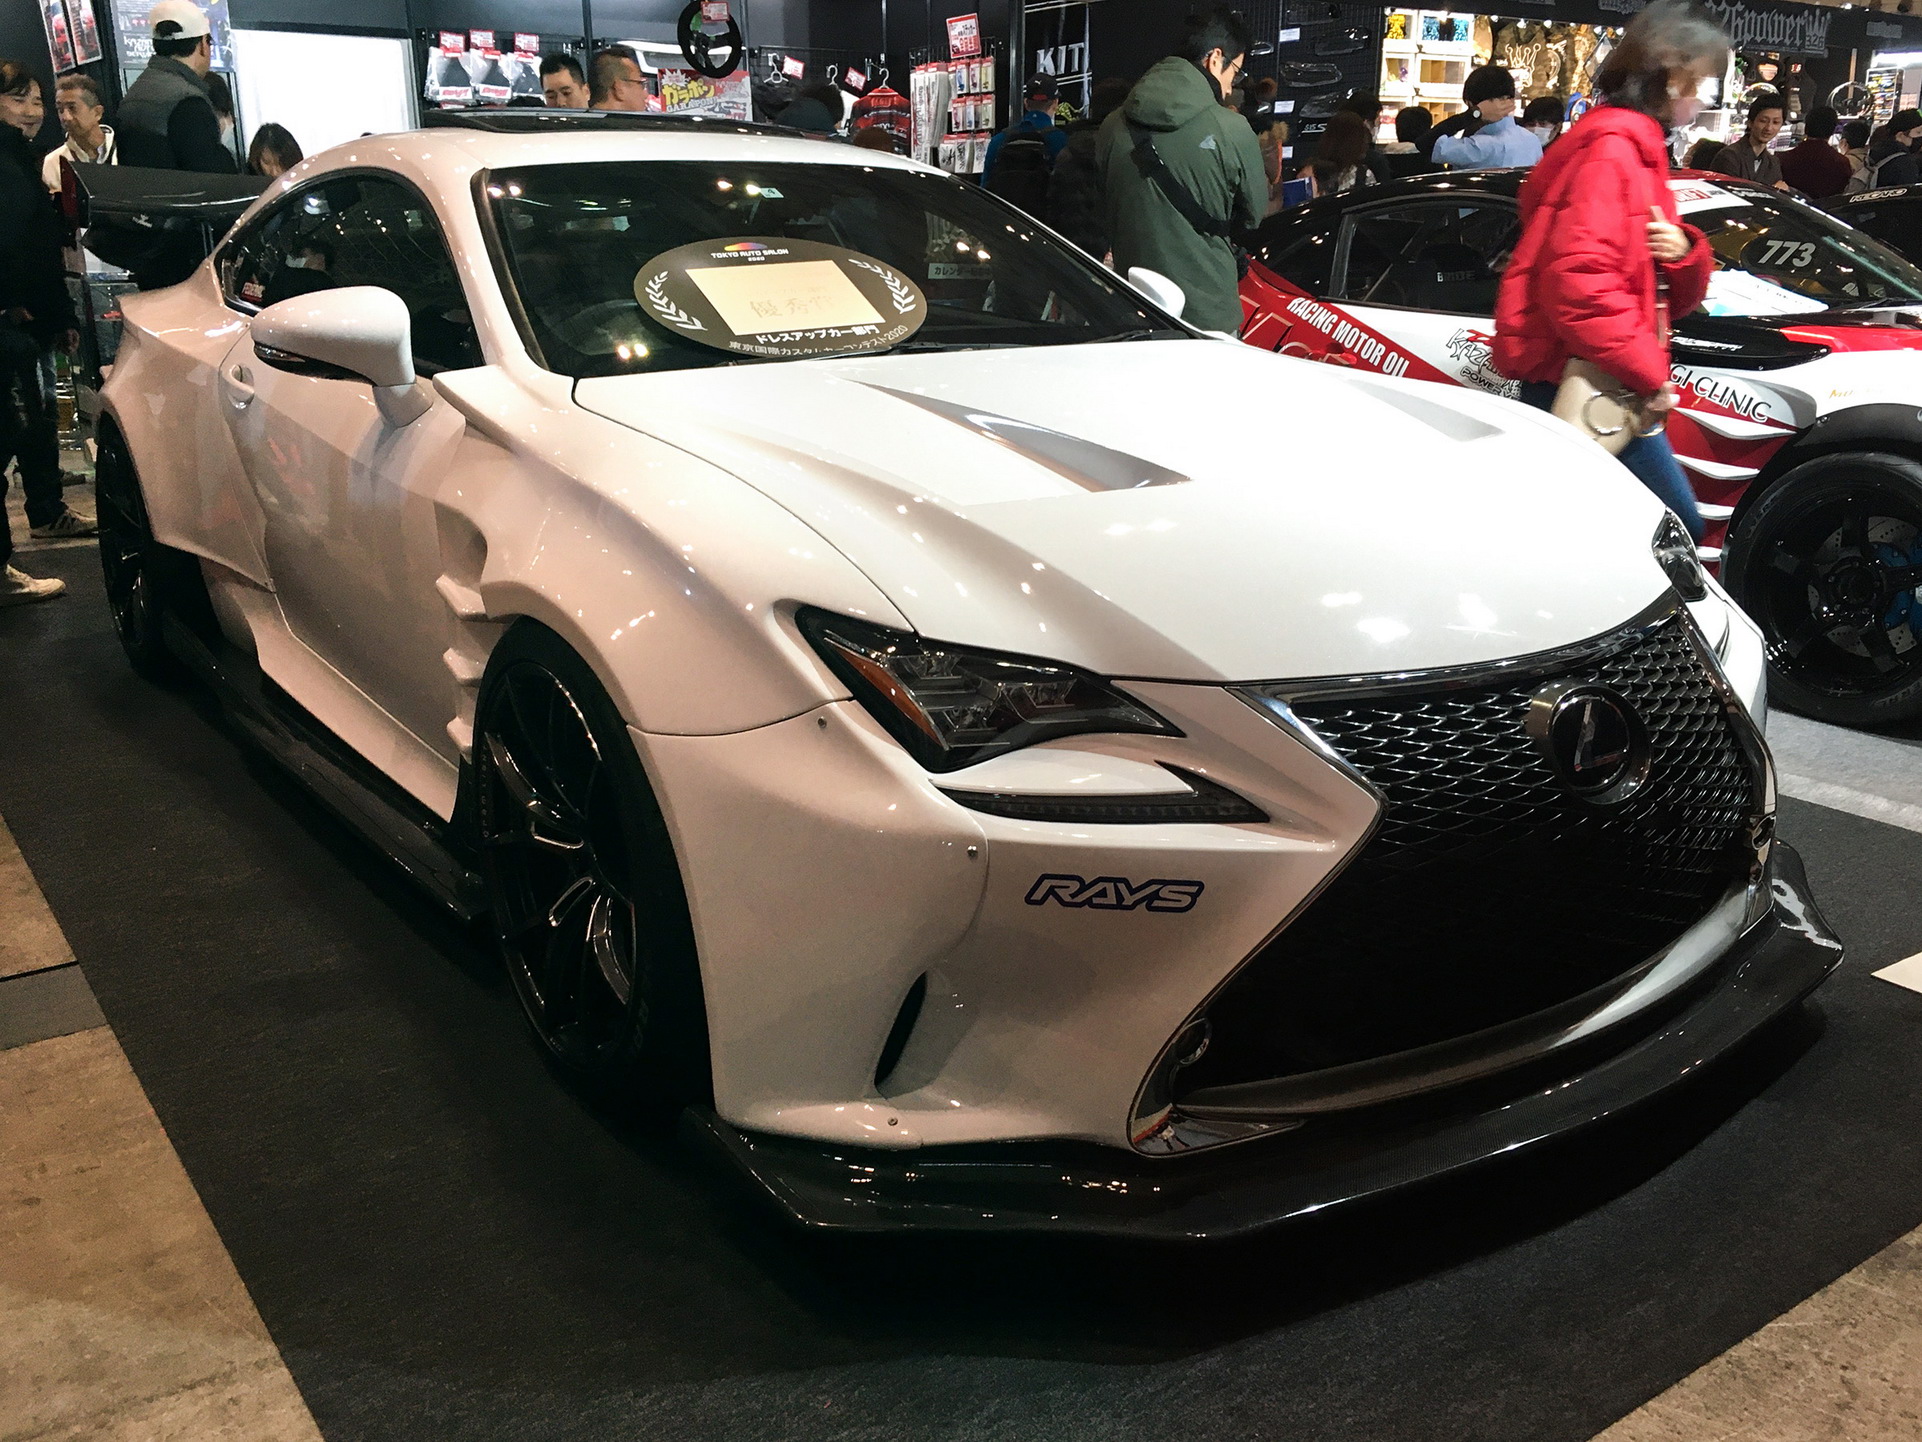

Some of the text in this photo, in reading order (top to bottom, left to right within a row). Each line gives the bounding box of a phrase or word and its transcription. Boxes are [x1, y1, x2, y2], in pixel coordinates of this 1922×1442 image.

[1036, 42, 1085, 76] KIT
[1849, 188, 1908, 203] RECARO
[762, 248, 789, 256] SALON
[1758, 240, 1816, 267] 773
[755, 324, 880, 344] ドレスアップカー部門
[1286, 297, 1335, 334] RACING
[1331, 319, 1385, 367] MOTOR
[1381, 350, 1410, 377] OIL
[1460, 366, 1502, 397] POWER
[1669, 364, 1772, 423] GI CLINIC
[1025, 873, 1205, 913] RAYS
